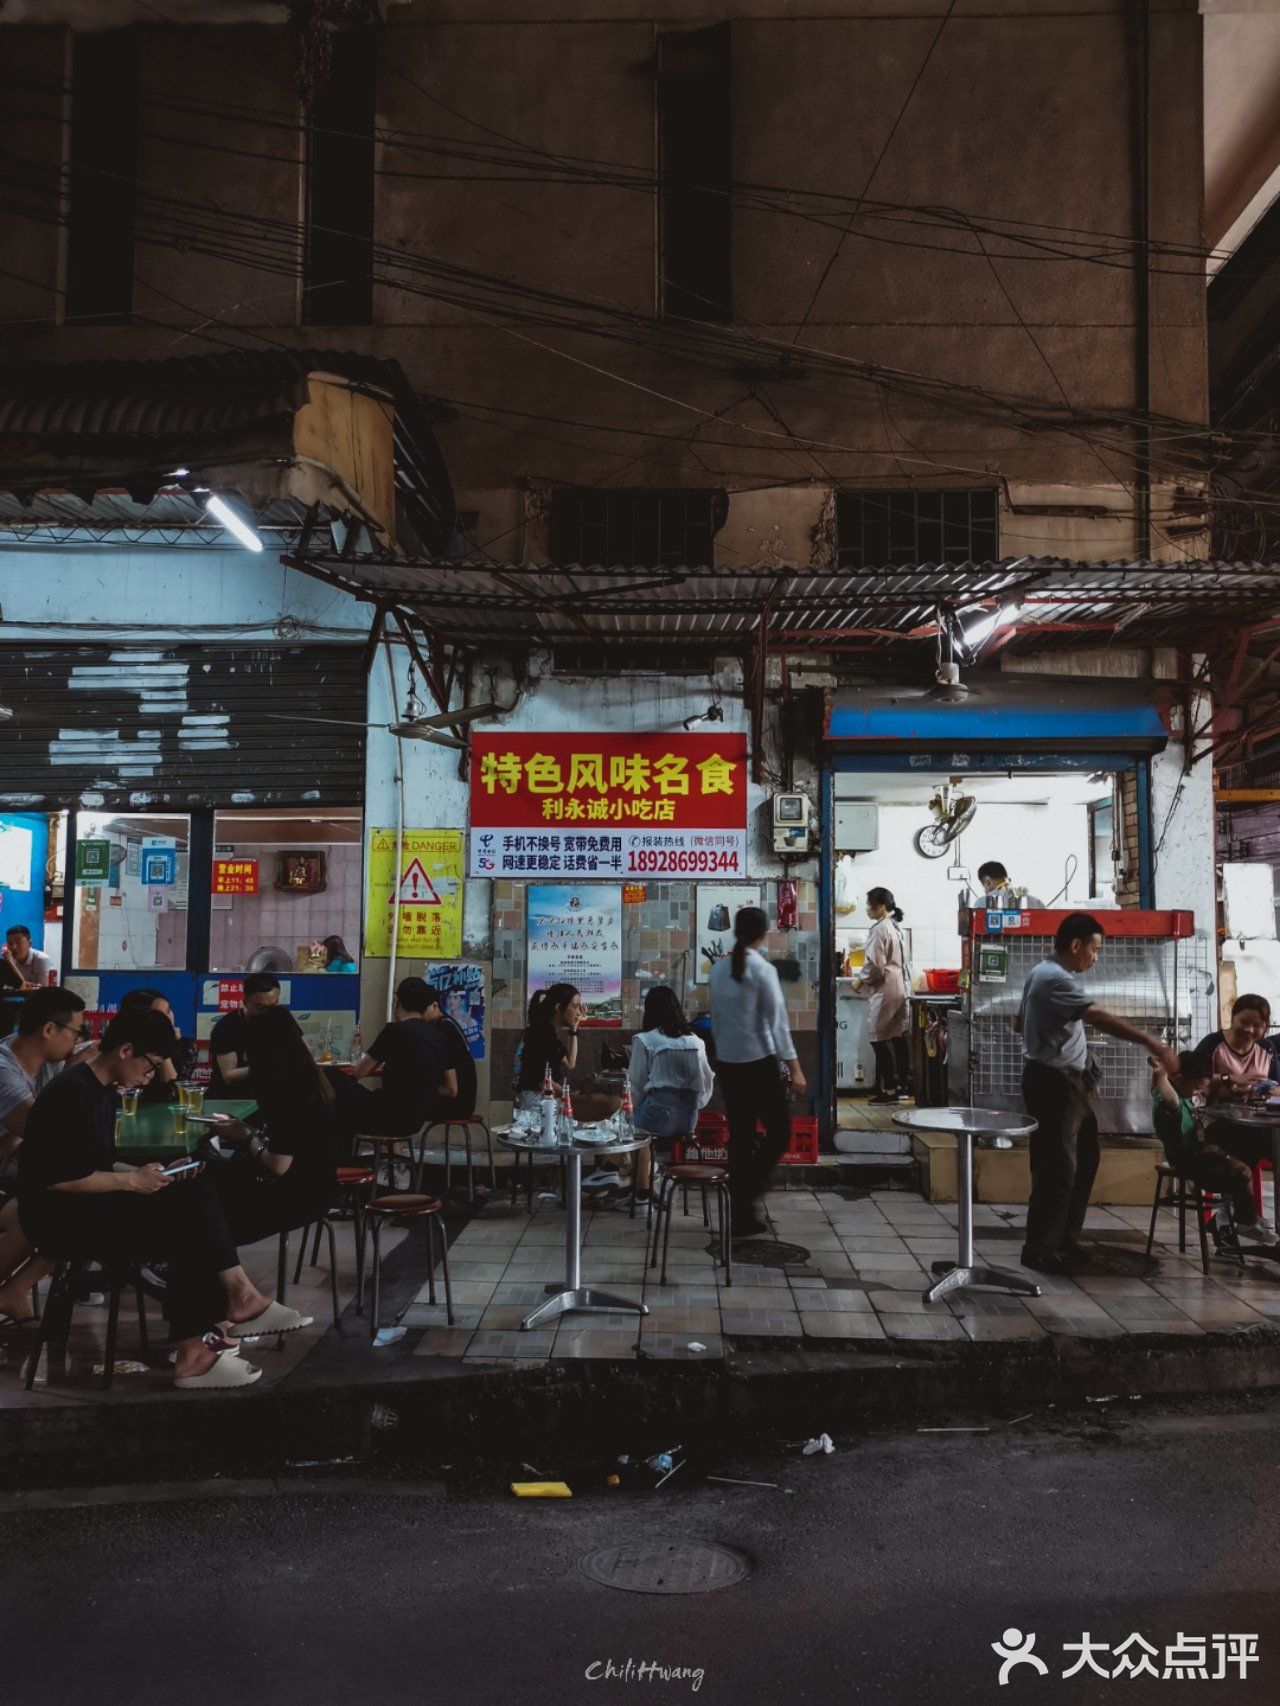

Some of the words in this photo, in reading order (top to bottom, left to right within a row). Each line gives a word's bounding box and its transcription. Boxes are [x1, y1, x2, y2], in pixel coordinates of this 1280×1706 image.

[481, 752, 737, 795] 特色风味名食
[542, 798, 676, 821] 利永诚小吃店
[412, 841, 457, 851] DANGER
[502, 836, 561, 852] 手机不换号
[563, 836, 622, 852] 宽带免费用
[642, 836, 685, 847] 报装热线
[478, 857, 495, 870] 5G
[502, 855, 561, 871] 网速更稳定
[563, 855, 622, 871] 话费省一半
[628, 850, 739, 872] 18928699344
